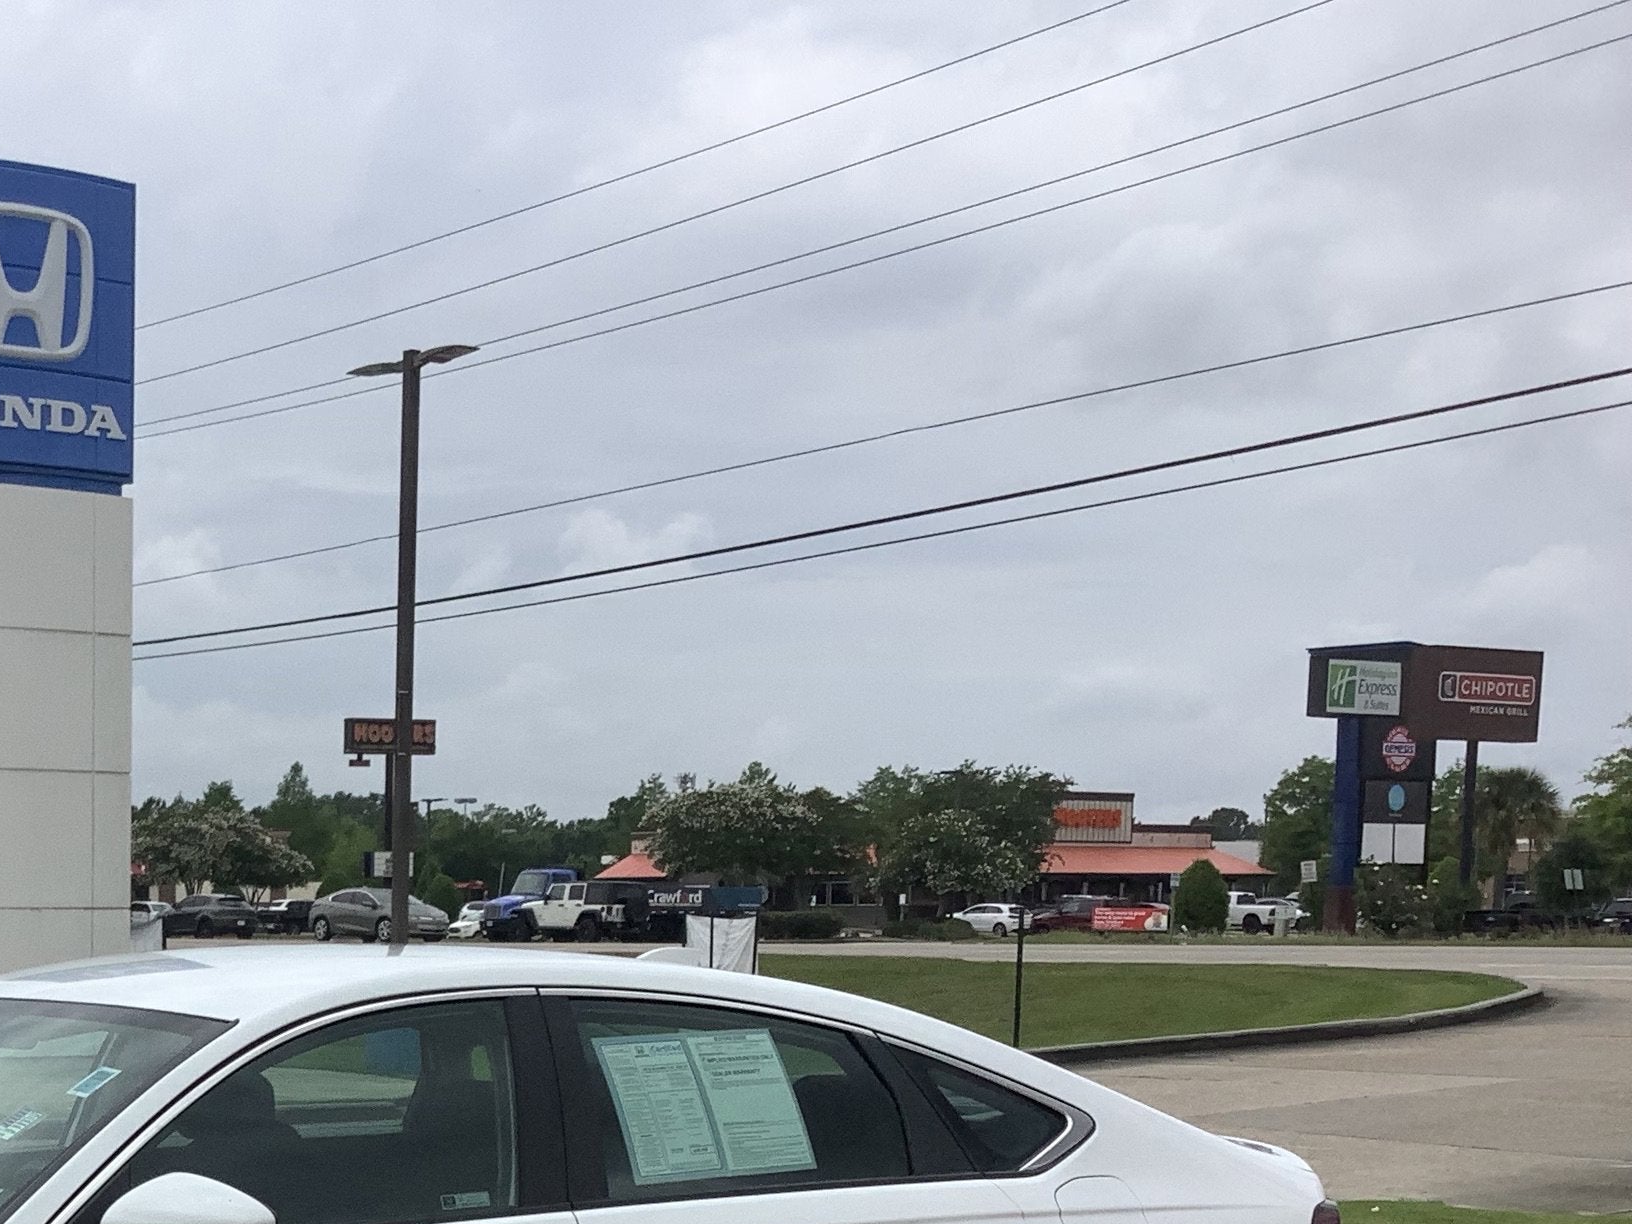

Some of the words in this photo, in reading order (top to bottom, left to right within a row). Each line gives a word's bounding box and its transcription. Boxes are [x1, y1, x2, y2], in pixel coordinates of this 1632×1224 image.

[1358, 679, 1398, 699] Express
[1461, 680, 1531, 698] CHIPOTLE
[1470, 705, 1505, 715] MEXICAN
[1506, 707, 1529, 717] GRILL
[354, 723, 434, 743] HOORS
